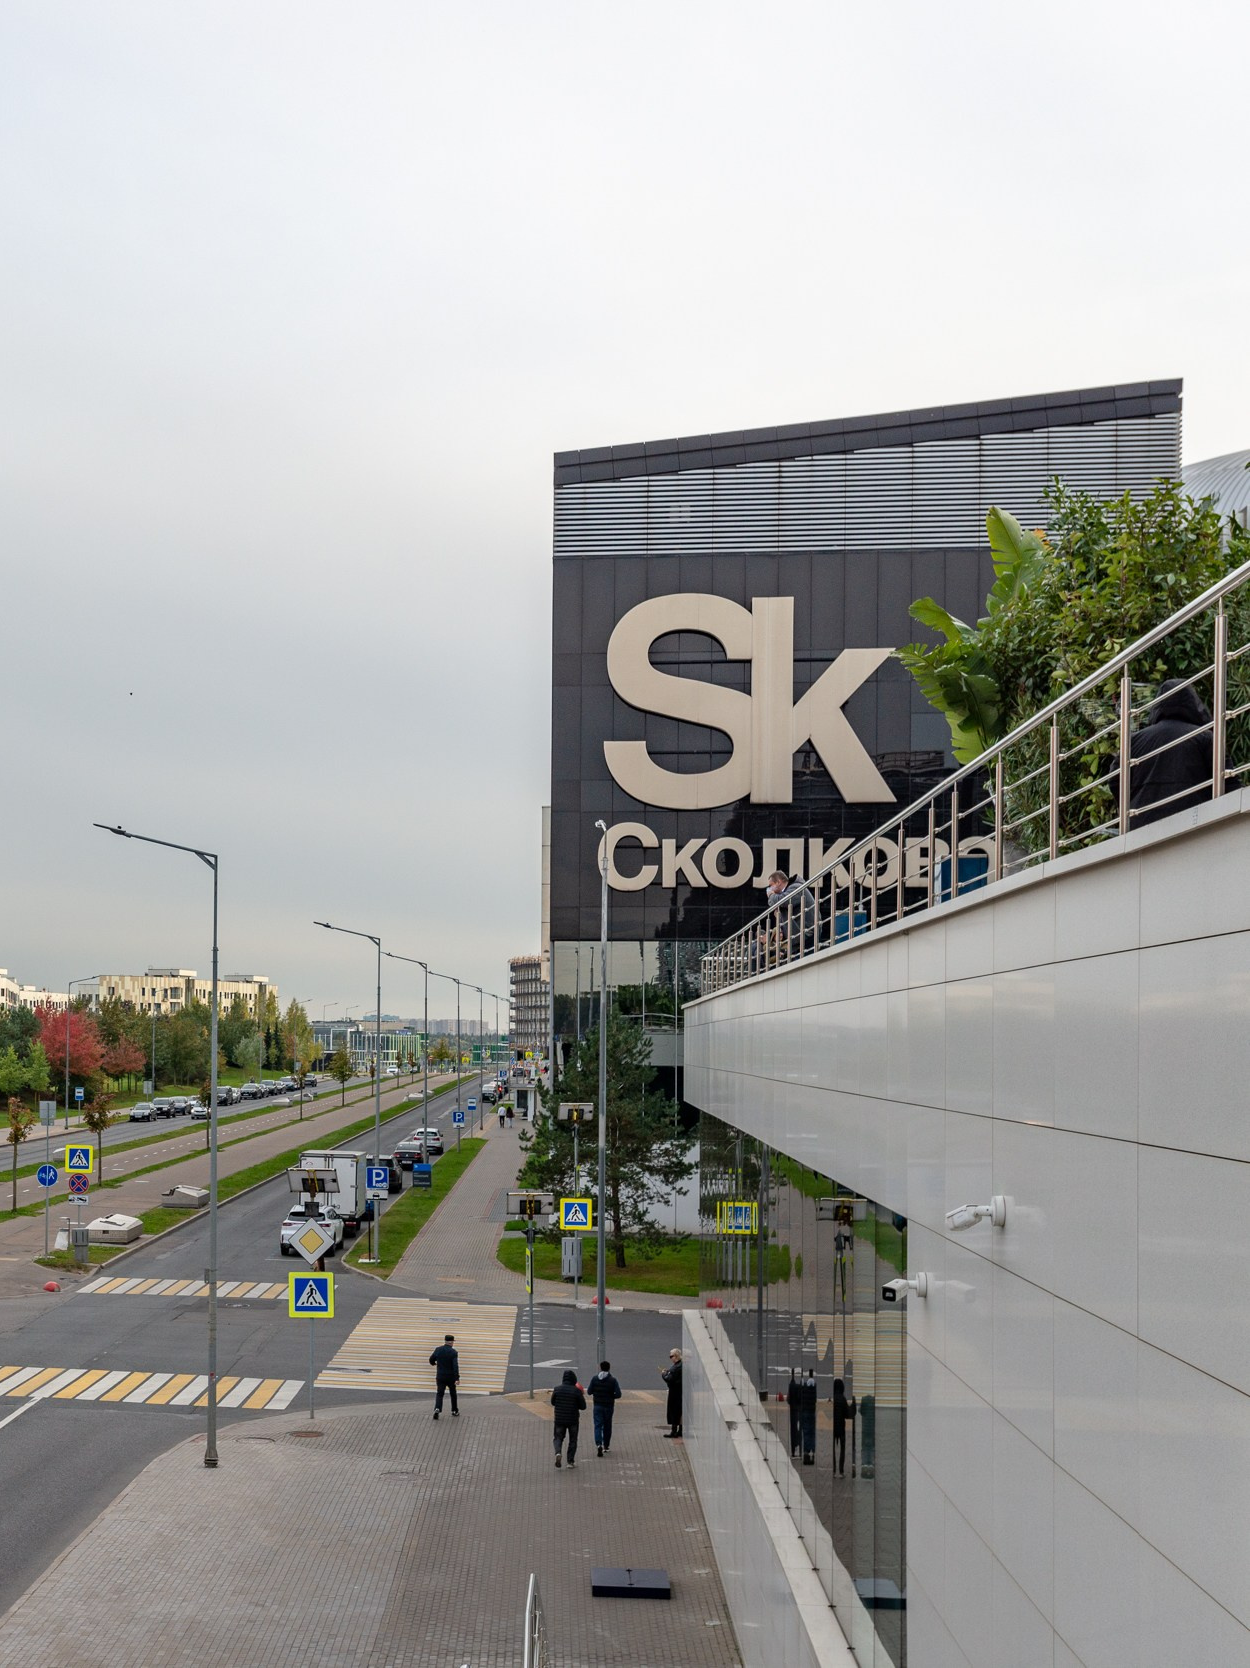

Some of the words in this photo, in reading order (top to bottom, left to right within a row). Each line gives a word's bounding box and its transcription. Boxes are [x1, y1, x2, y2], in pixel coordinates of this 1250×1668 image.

[603, 592, 898, 811] Sk
[455, 1112, 463, 1122] P
[372, 1169, 385, 1187] P
